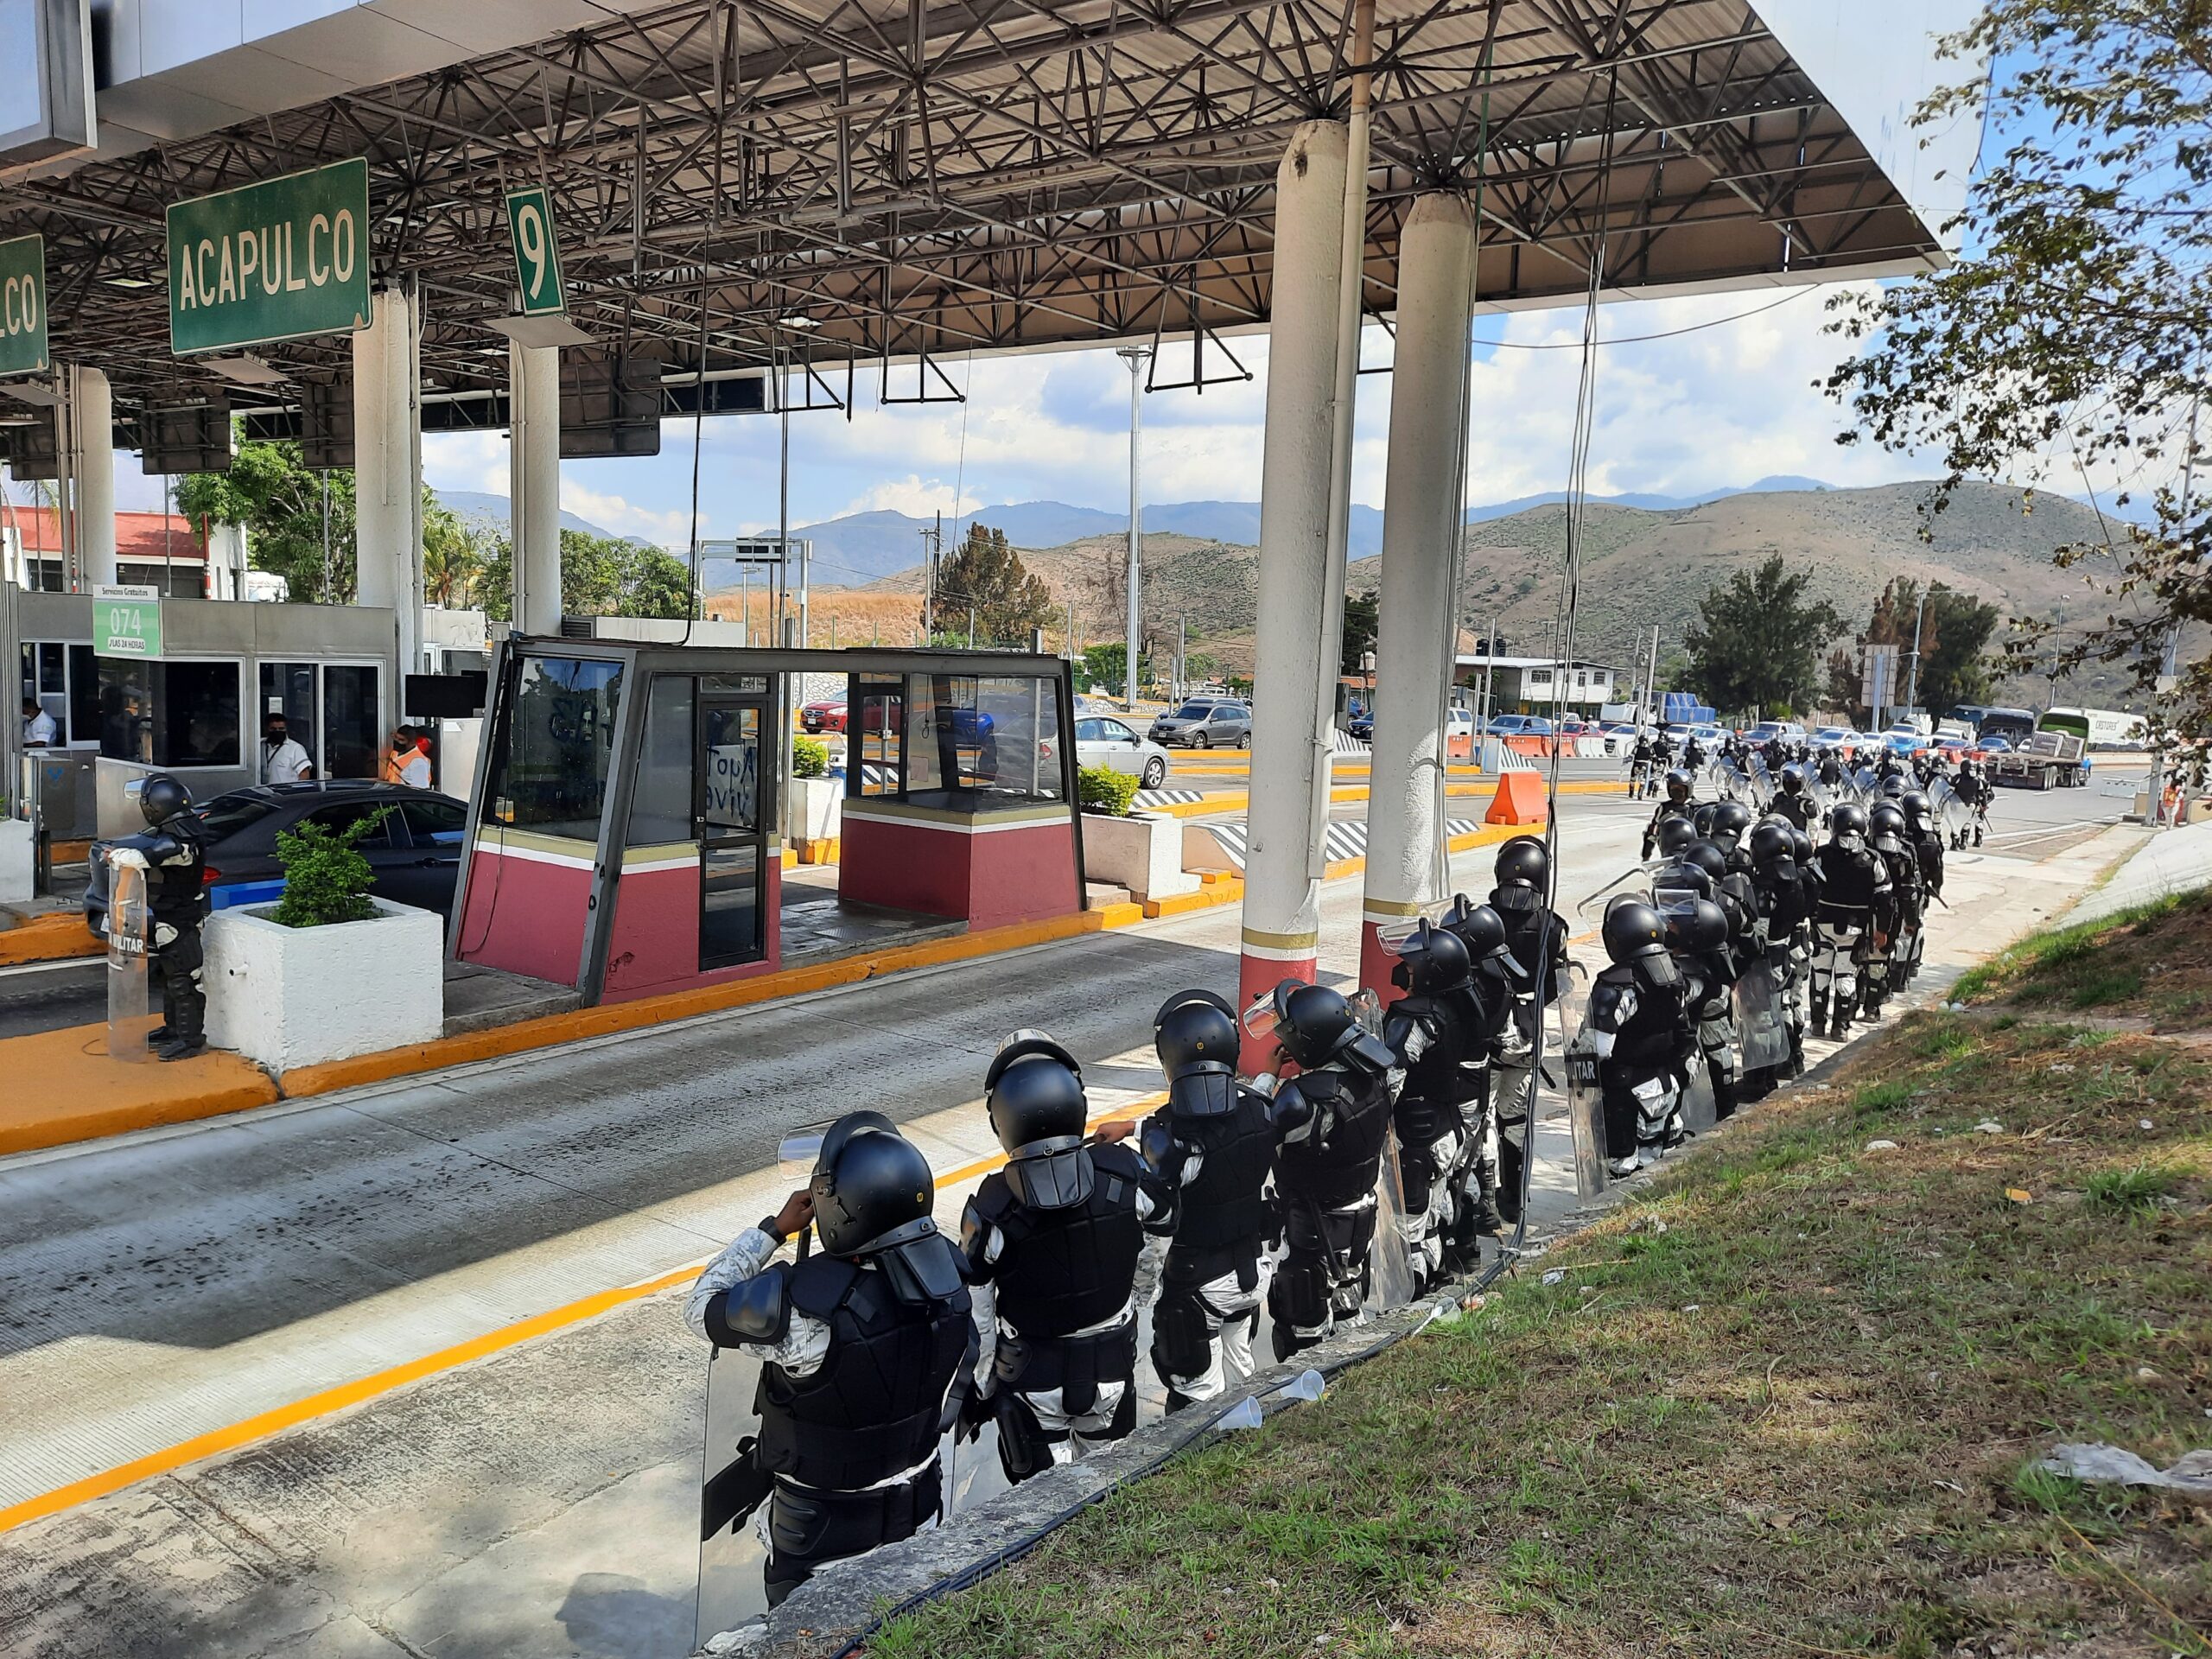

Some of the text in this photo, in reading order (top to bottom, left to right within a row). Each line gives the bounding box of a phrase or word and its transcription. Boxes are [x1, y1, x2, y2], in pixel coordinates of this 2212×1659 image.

[181, 208, 354, 311] ACAPULCO
[518, 204, 545, 301] 9
[0, 274, 37, 337] CO
[110, 607, 142, 636] 074
